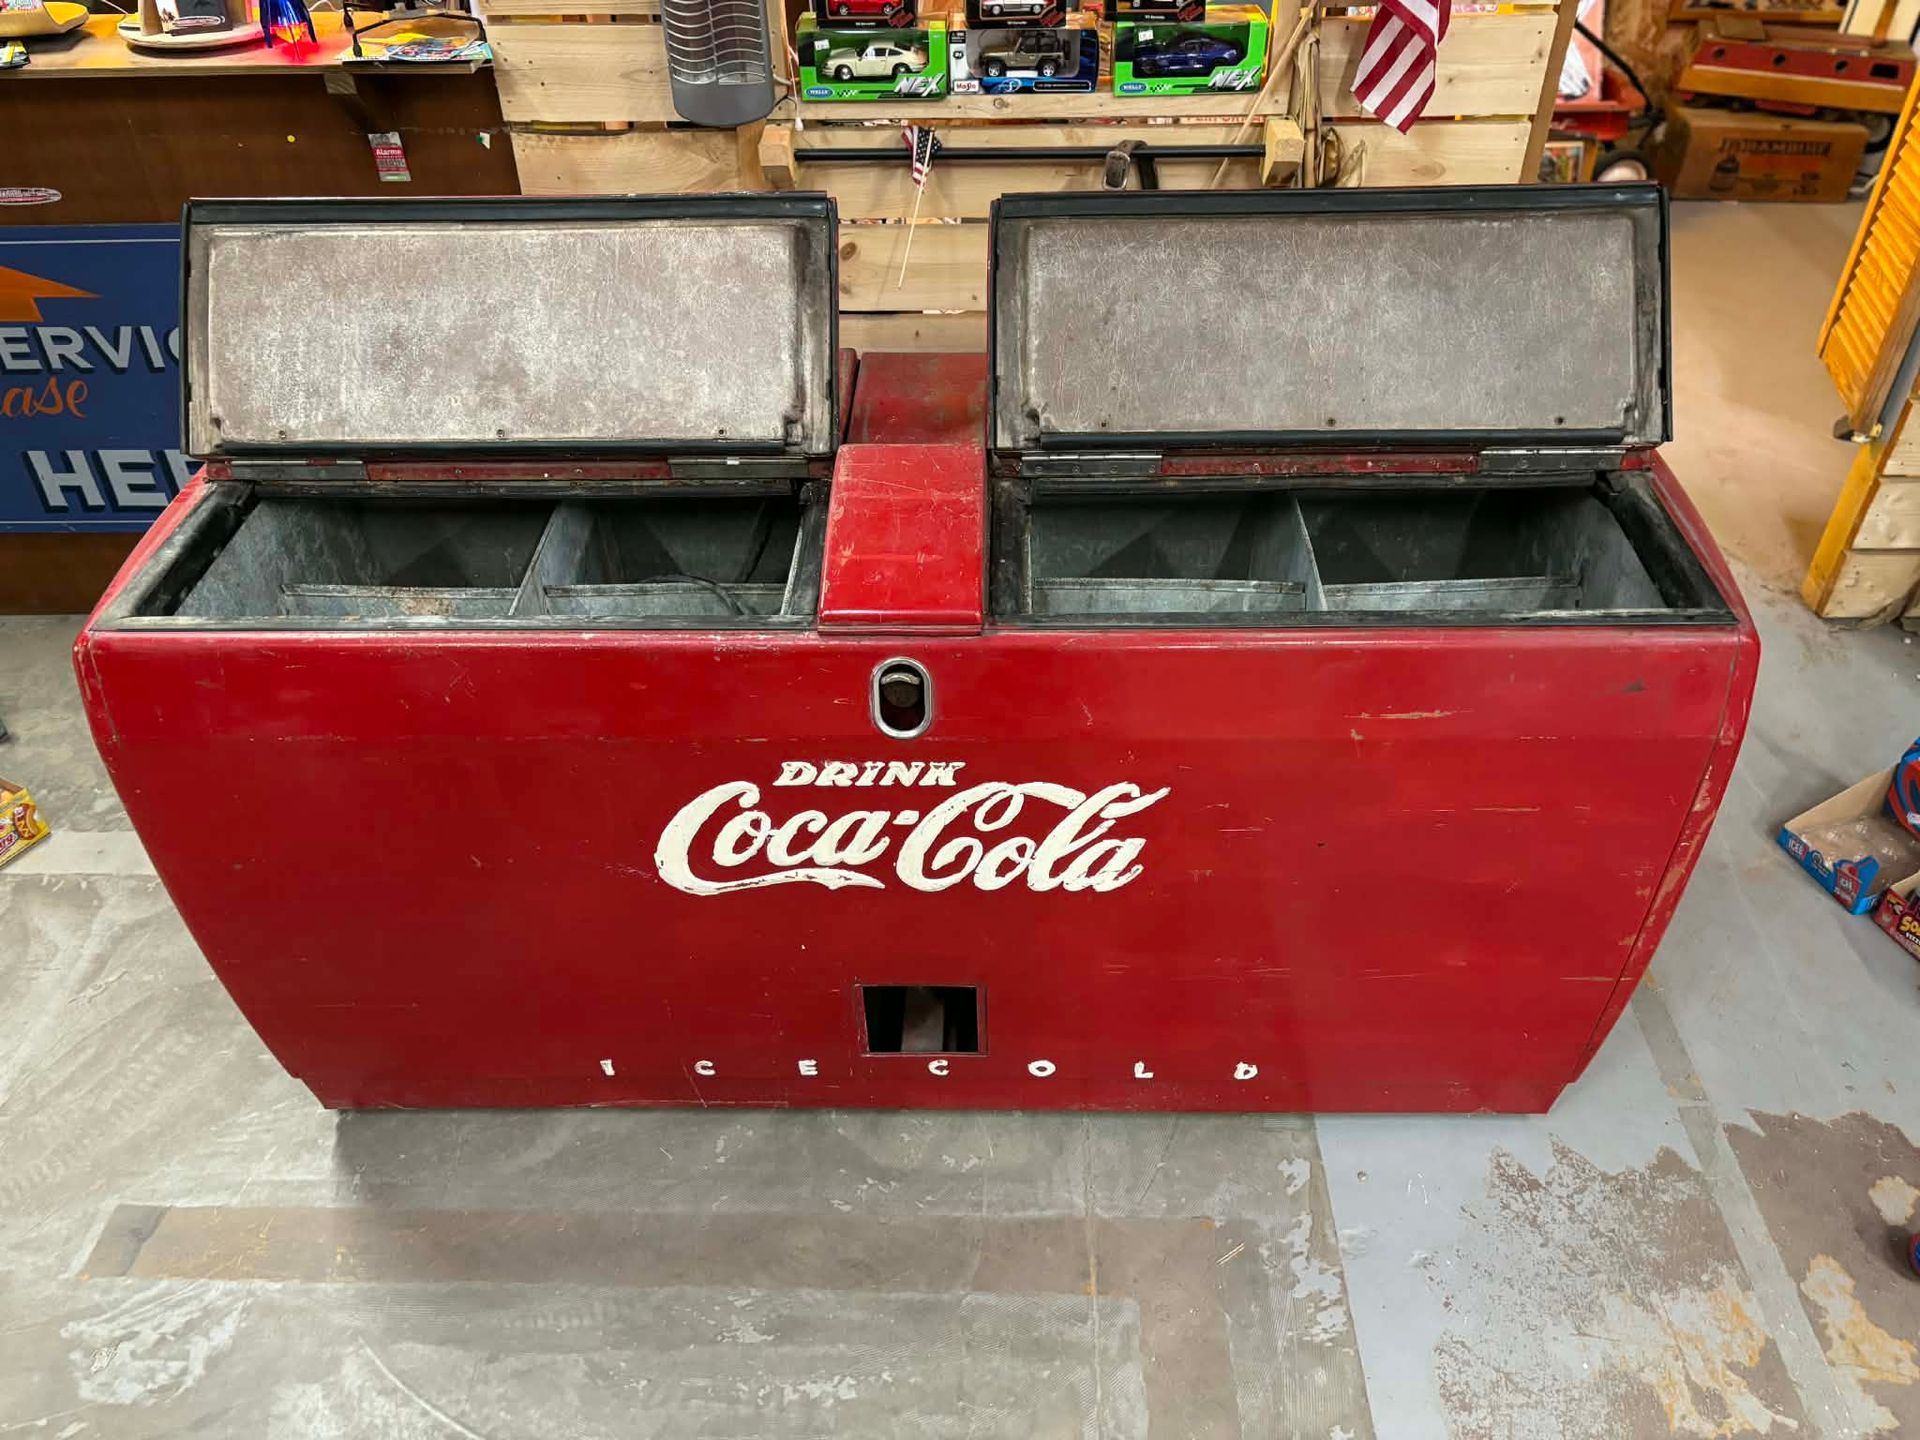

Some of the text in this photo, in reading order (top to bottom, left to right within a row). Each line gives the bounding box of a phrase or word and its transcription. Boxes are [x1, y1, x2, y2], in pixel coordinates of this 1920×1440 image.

[895, 73, 945, 97] NEX
[1207, 66, 1261, 91] NEX
[773, 761, 965, 786] DRINK
[654, 781, 1171, 896] Coca-Cola
[1900, 916, 1920, 937] SO
[599, 1059, 1258, 1080] ICE COLD
